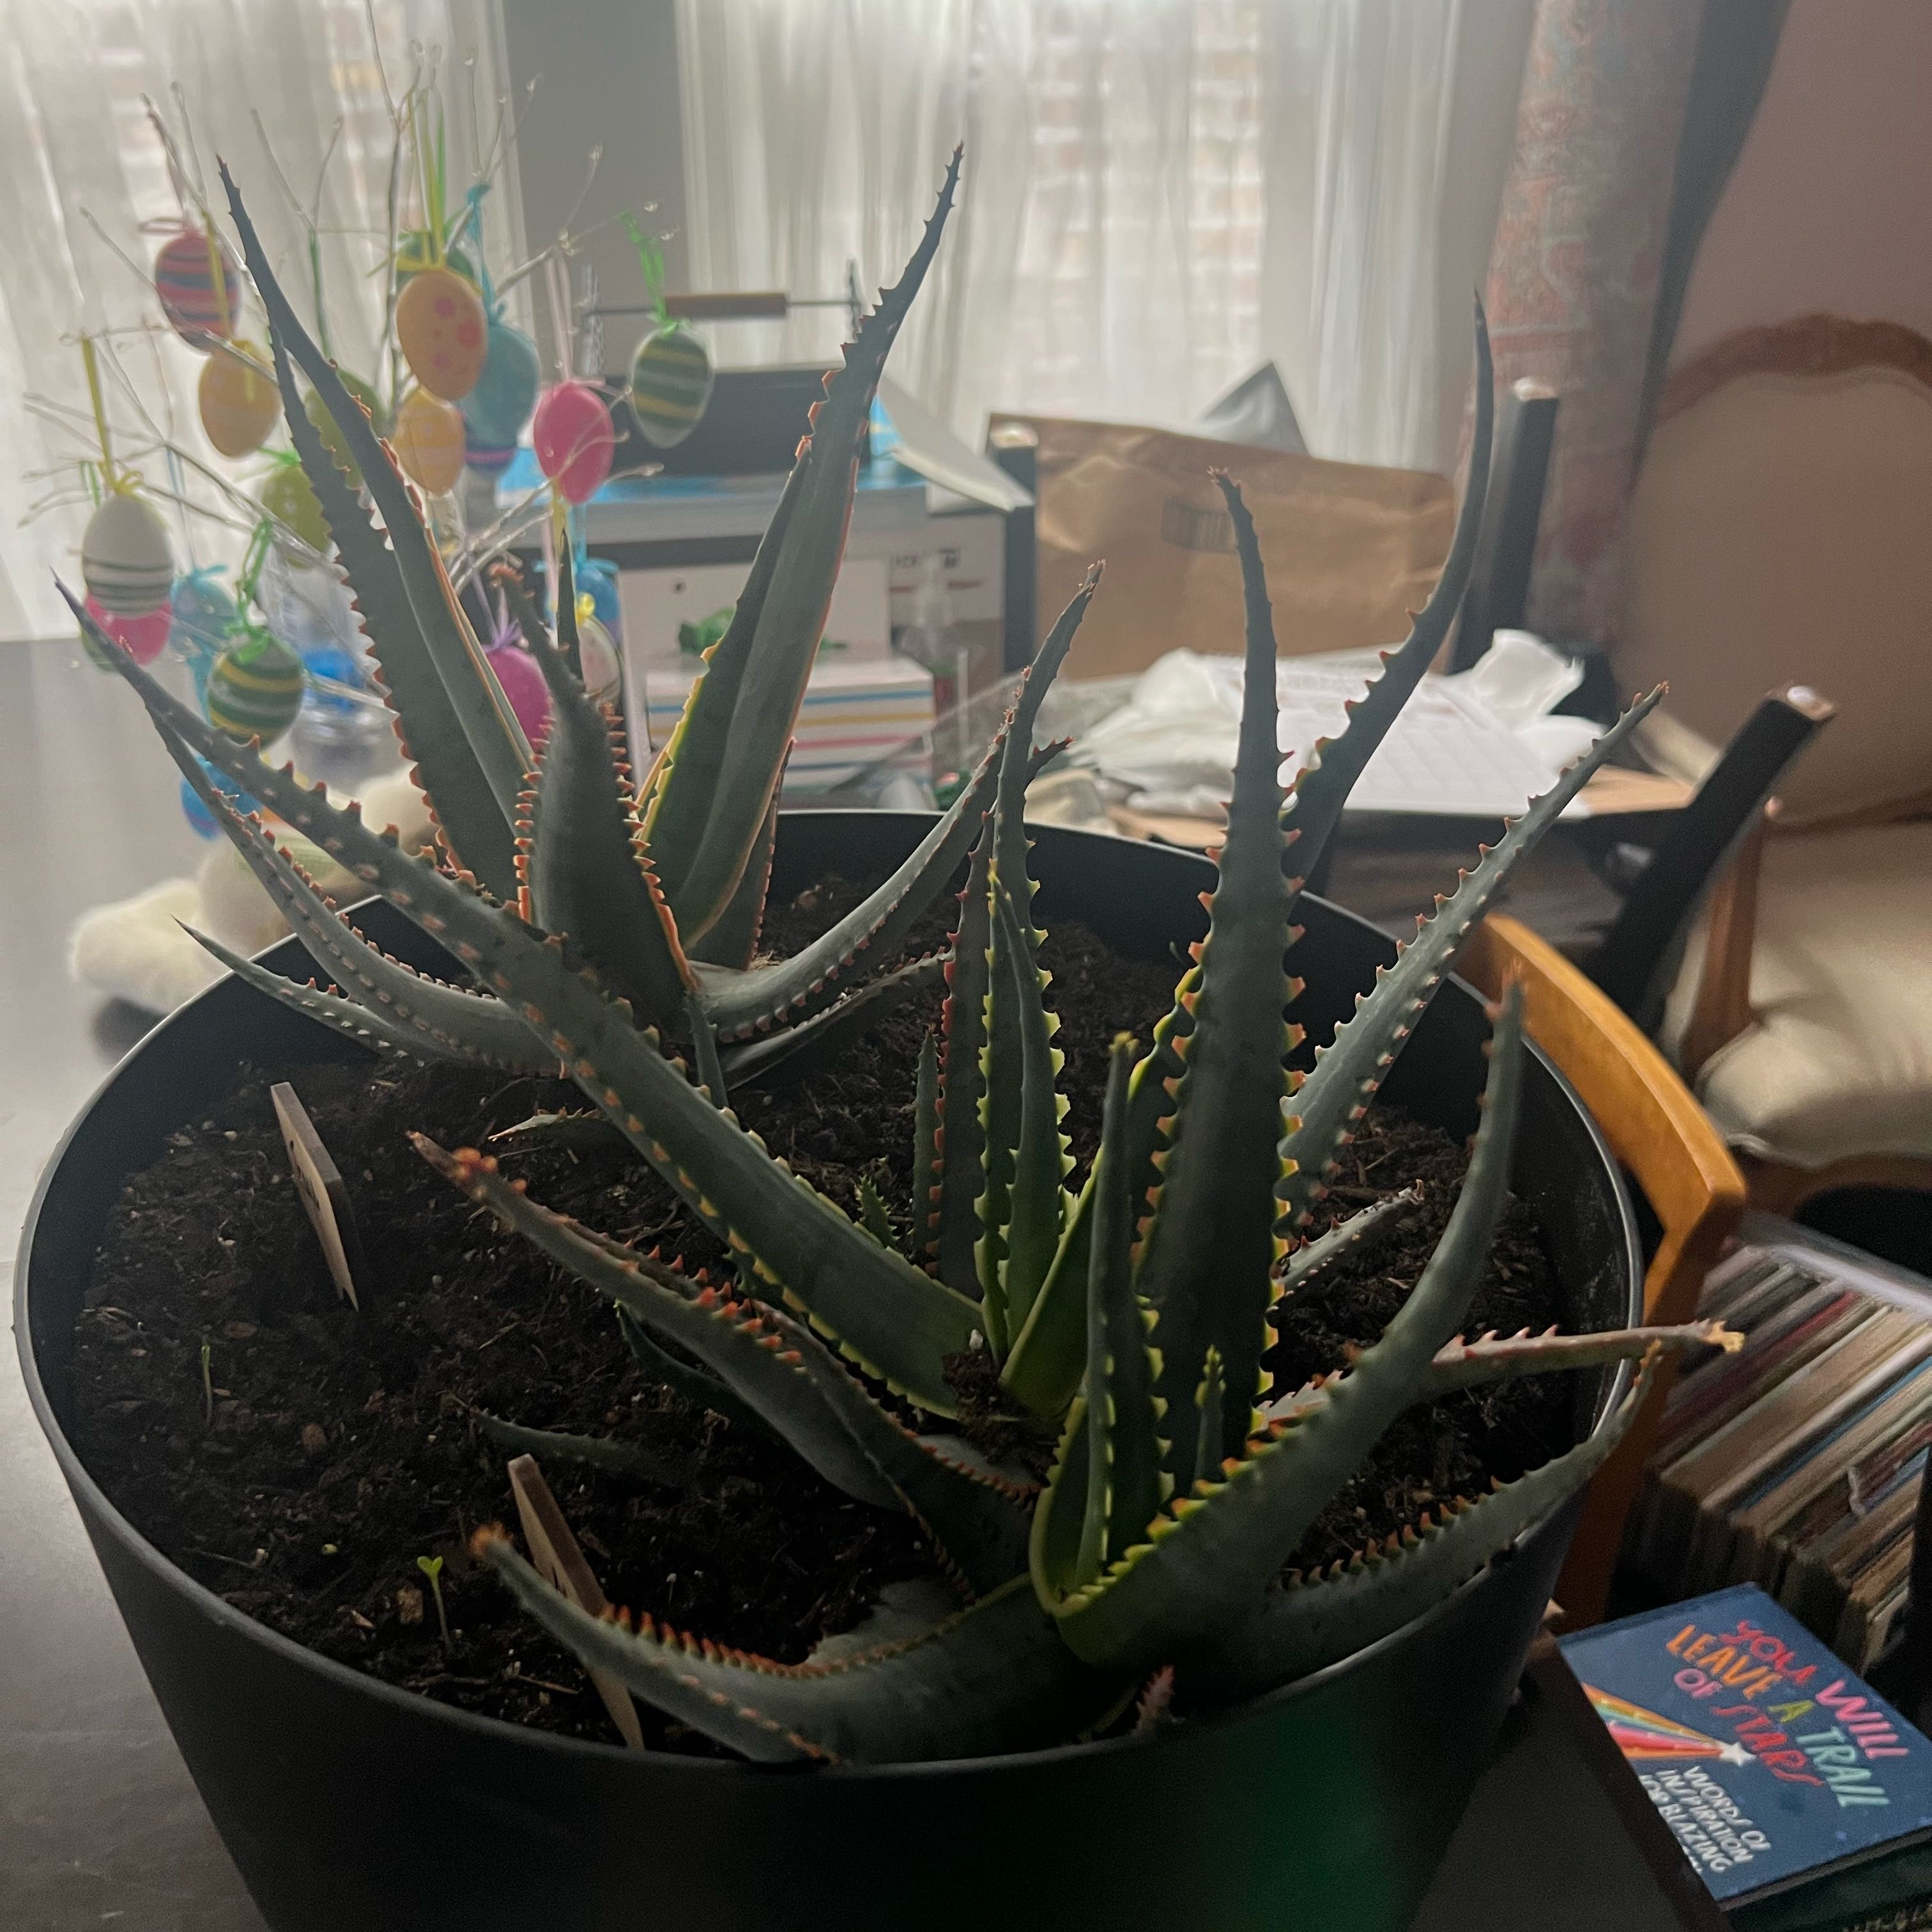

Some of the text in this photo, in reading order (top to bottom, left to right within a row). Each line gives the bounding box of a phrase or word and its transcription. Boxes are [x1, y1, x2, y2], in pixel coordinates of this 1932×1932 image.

[1666, 1625, 1890, 1807] LEAVE A TRAIL
[1674, 1668, 1825, 1786] OF STARS
[1815, 1679, 1909, 1759] WILL
[1656, 1769, 1753, 1863] INSPIRATION
[1659, 1804, 1733, 1873] BLAZING
[1683, 1766, 1754, 1827] WORDS
[1741, 1830, 1772, 1851] OF
